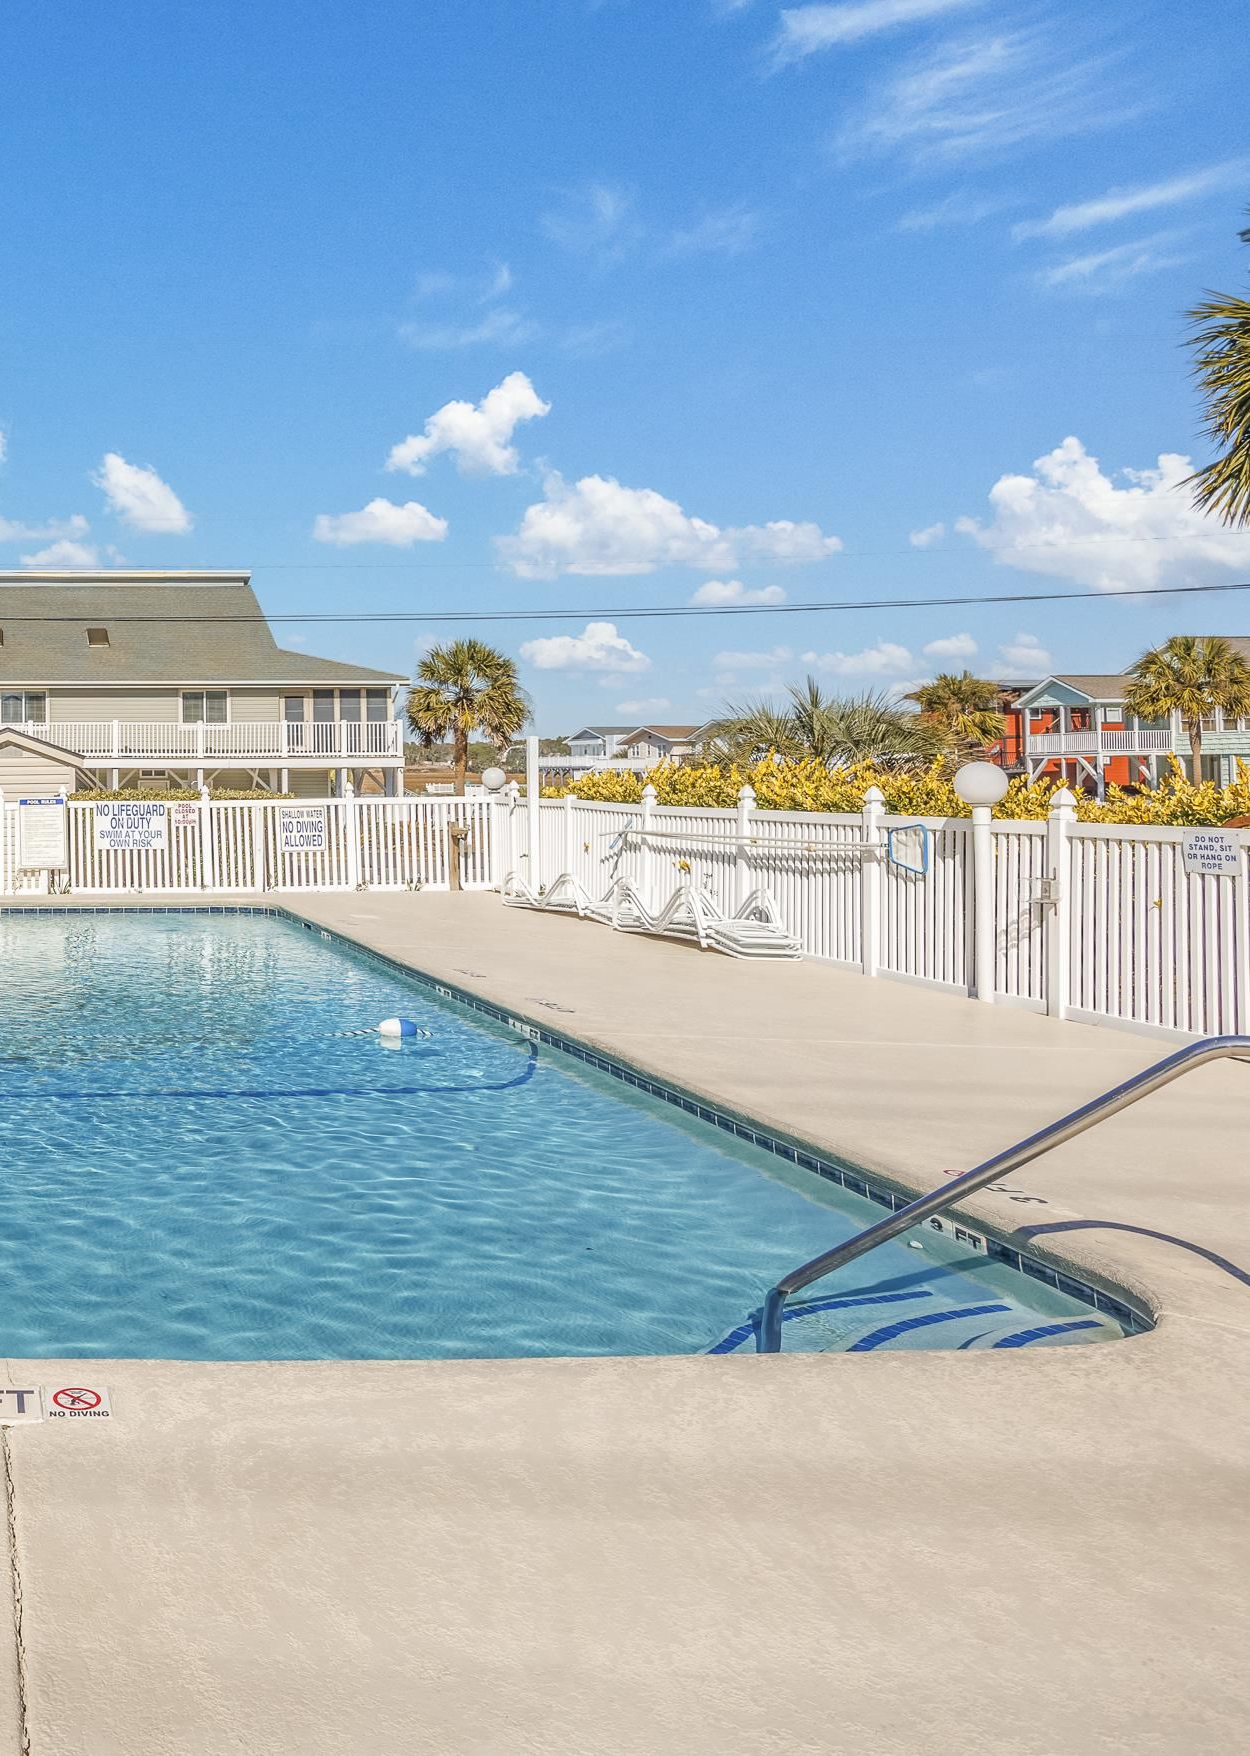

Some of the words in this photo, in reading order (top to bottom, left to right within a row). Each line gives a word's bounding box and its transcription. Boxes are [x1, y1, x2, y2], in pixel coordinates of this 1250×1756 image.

[96, 804, 110, 816] NO
[112, 804, 165, 816] LIFEGUARD
[281, 810, 305, 819] SHALLOW
[306, 809, 323, 818] WATER
[110, 817, 124, 829] ON
[126, 817, 151, 829] DUTY
[282, 820, 294, 833] NO
[296, 820, 323, 833] DIVING
[99, 830, 122, 839] SWIM
[124, 830, 136, 839] AT
[138, 830, 163, 839] YOUR
[109, 839, 130, 847] OWN
[132, 839, 152, 847] RISK
[284, 834, 323, 847] ALLOWED
[1188, 843, 1218, 852] STAND,
[1219, 844, 1233, 852] SIT
[1201, 862, 1223, 870] ROPE
[929, 1217, 944, 1232] 3
[955, 1226, 981, 1249] FT
